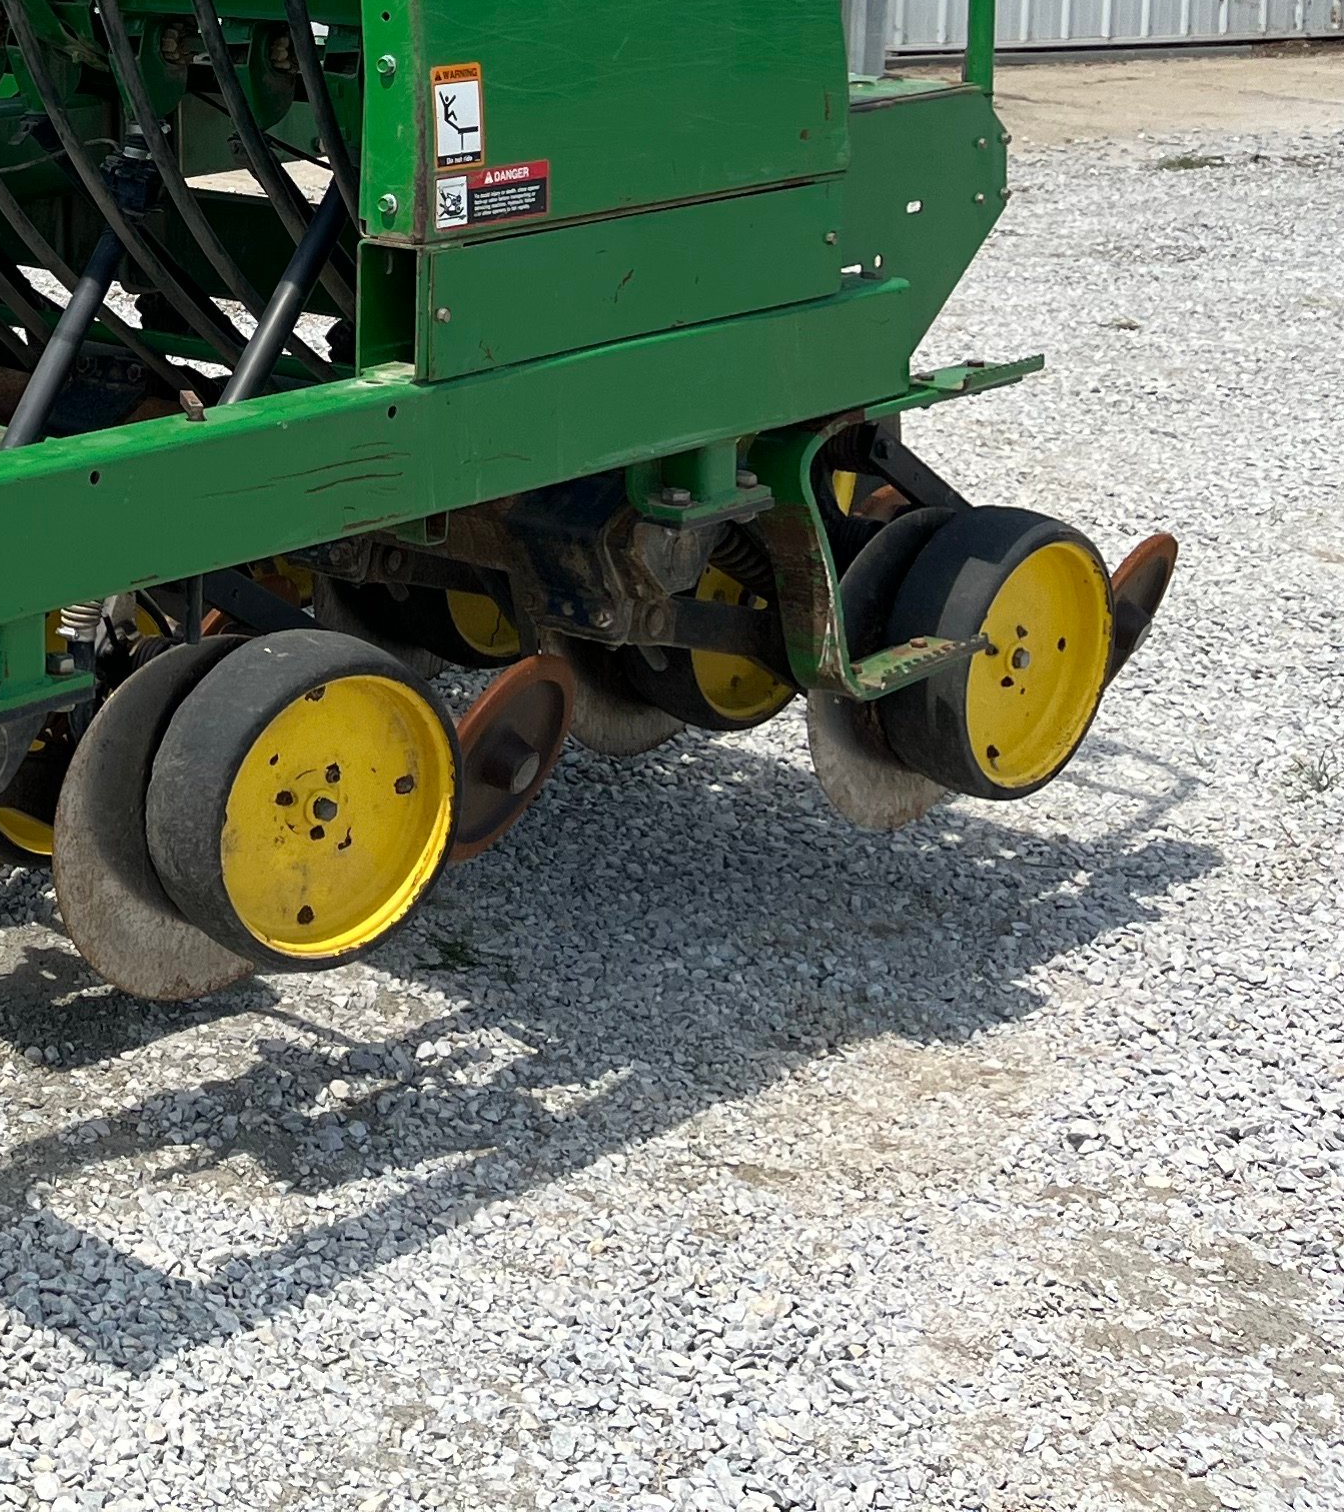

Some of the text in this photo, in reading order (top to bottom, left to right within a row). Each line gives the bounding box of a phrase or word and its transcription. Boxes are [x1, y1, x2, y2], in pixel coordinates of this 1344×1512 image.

[442, 68, 477, 80] WARNING
[446, 154, 473, 165] Do not ride
[493, 167, 529, 183] DANGER
